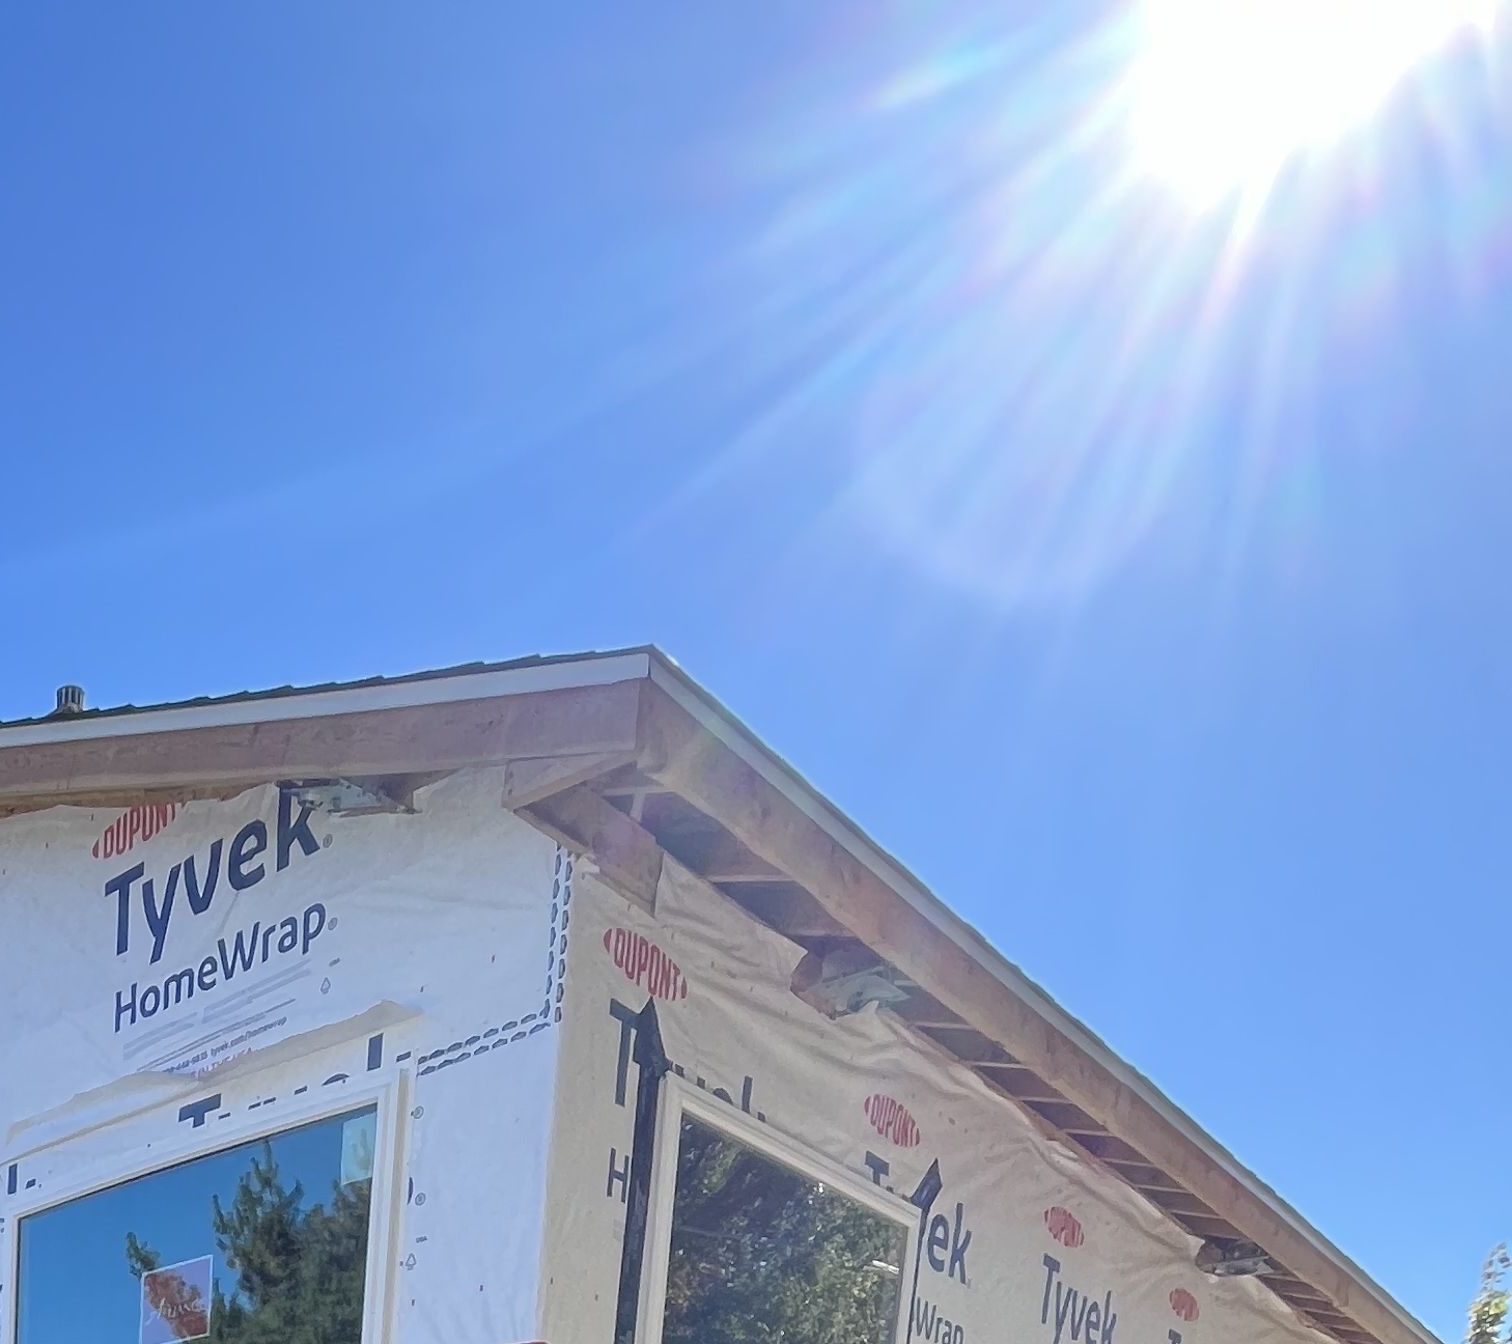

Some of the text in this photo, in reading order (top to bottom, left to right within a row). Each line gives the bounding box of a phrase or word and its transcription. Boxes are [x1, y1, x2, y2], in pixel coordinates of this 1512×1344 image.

[105, 785, 320, 965] Tyvek
[114, 903, 326, 1033] HomeWrap
[614, 927, 681, 1001] DUPONT
